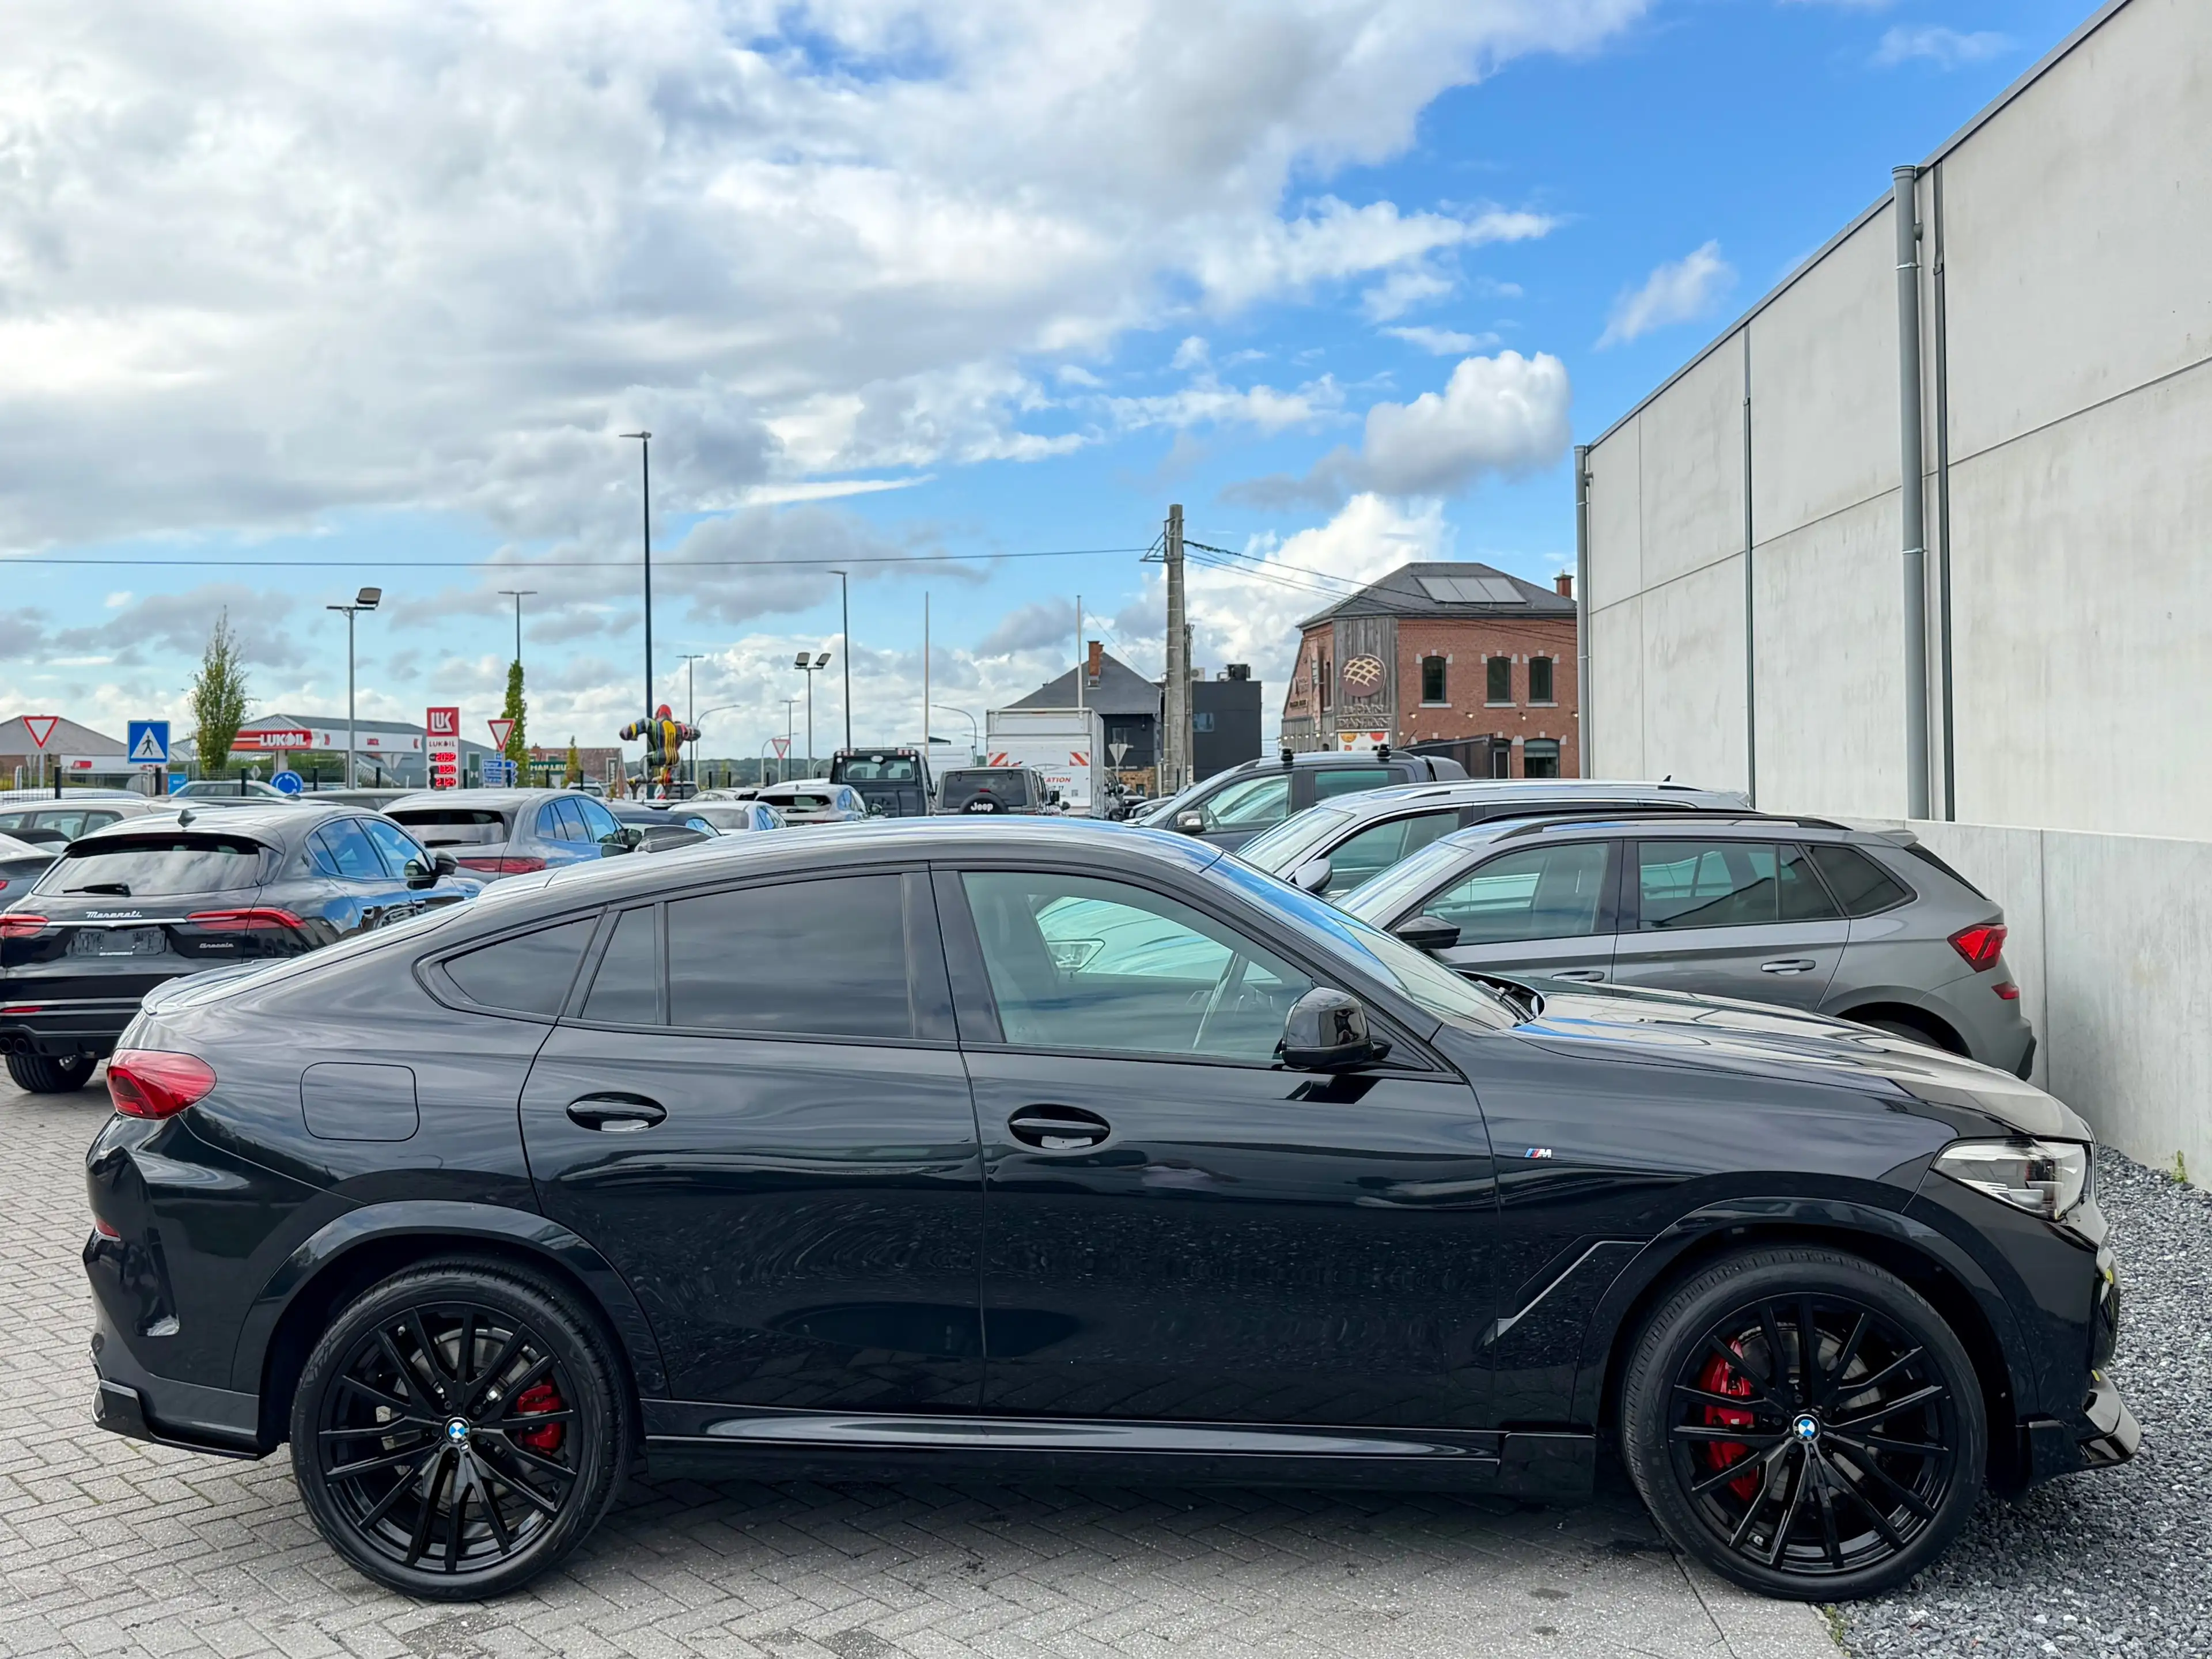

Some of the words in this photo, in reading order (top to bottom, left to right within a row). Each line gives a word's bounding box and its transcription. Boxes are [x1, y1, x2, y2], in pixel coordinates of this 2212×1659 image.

[260, 732, 306, 747] LUKOIL
[971, 802, 994, 812] Jeep
[86, 910, 142, 918] Maserati
